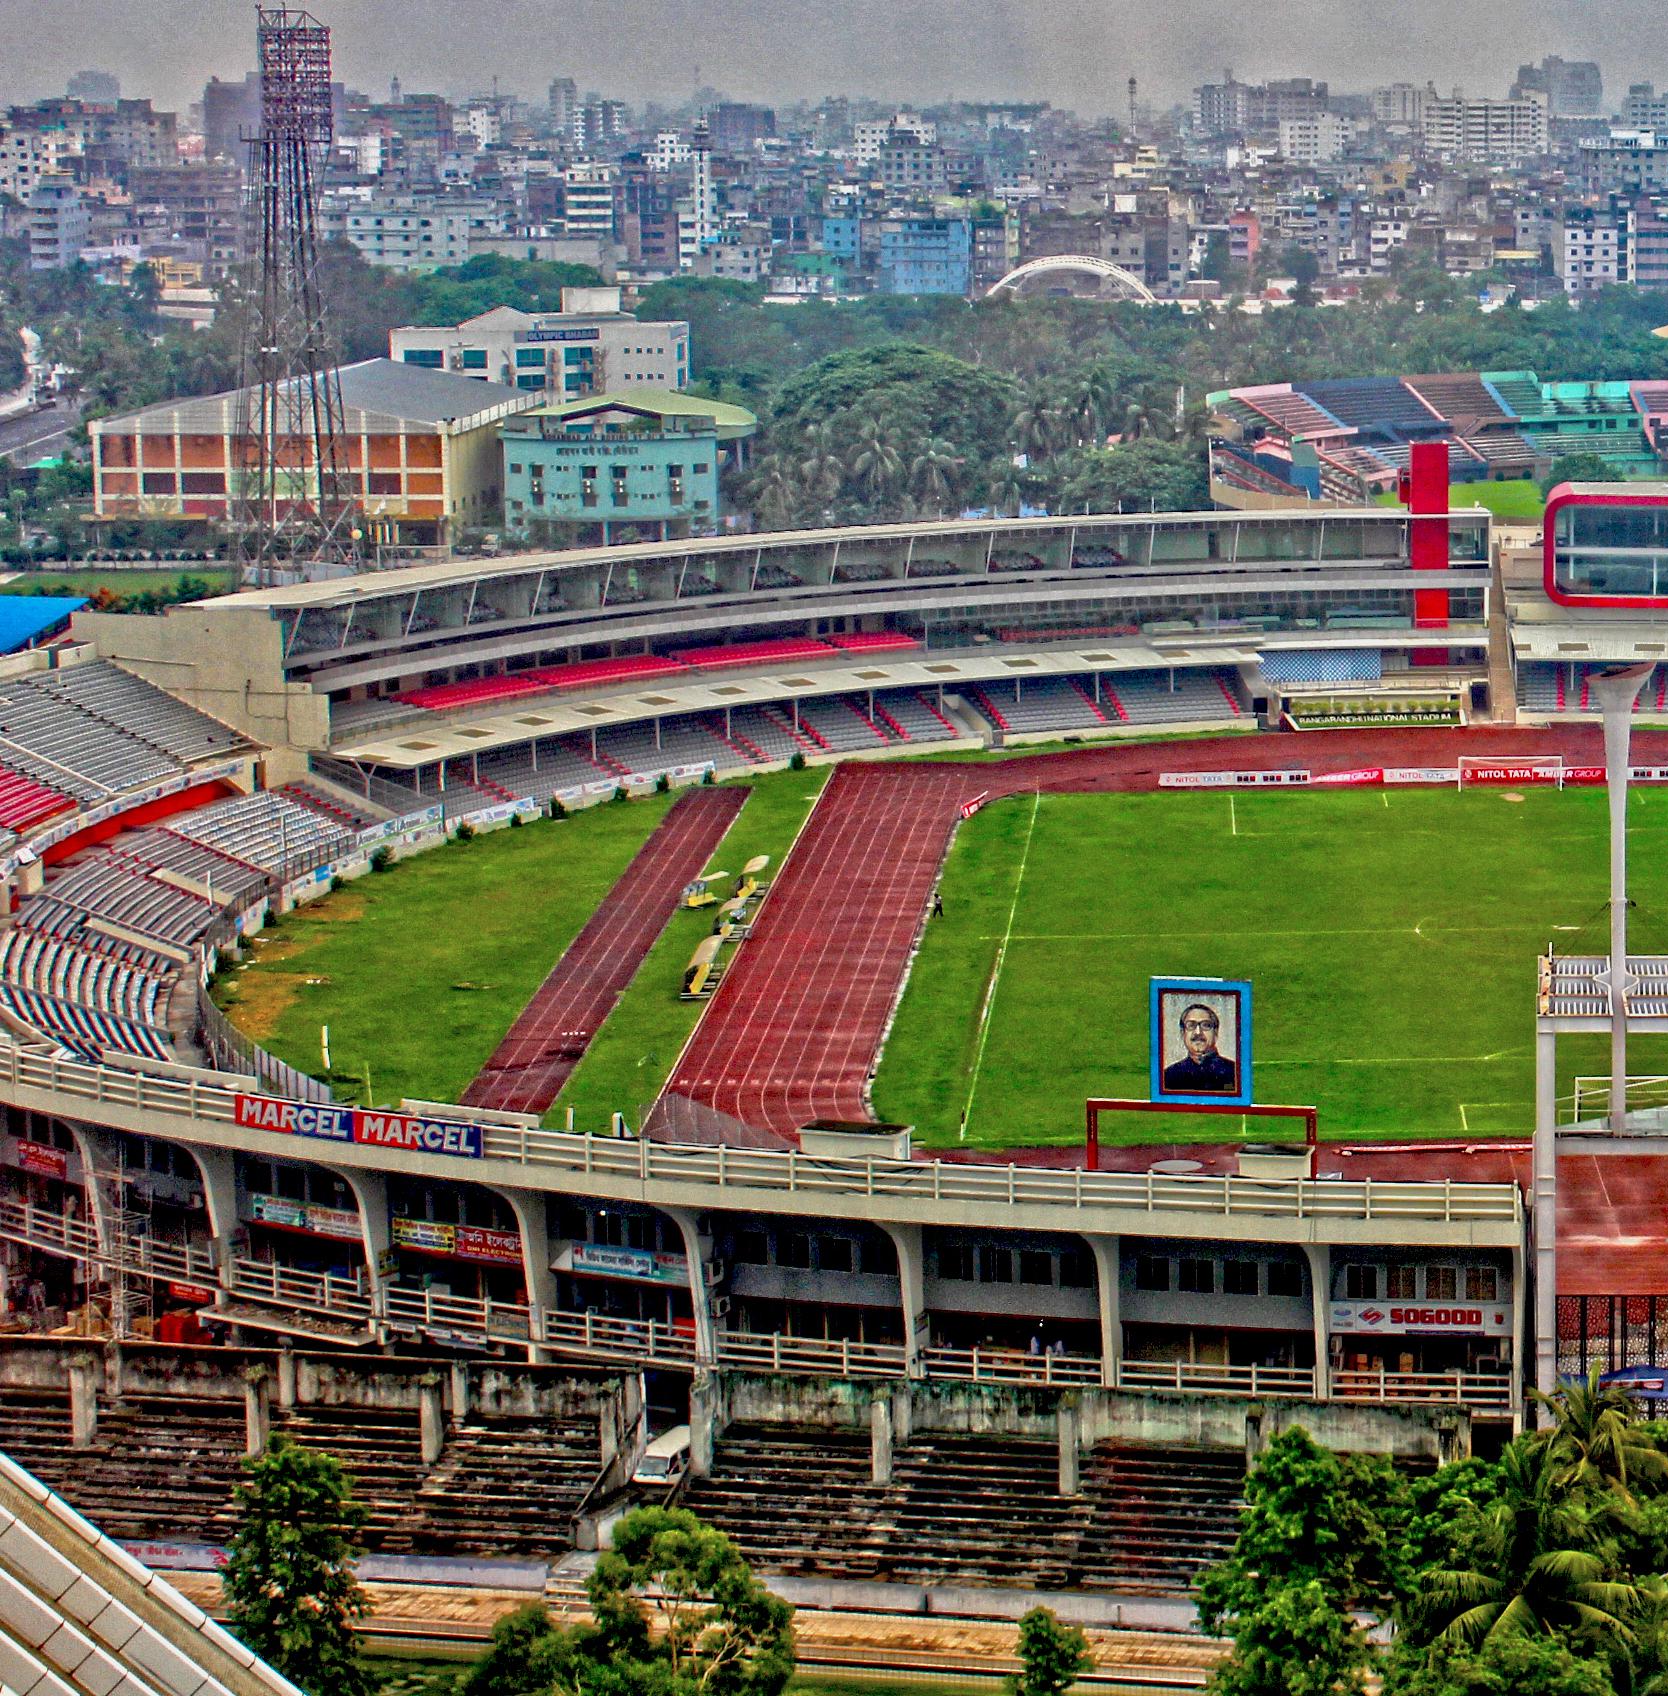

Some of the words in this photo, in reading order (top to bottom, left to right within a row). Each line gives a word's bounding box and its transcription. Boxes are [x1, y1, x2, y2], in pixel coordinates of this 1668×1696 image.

[1351, 770, 1379, 781] GROUP
[1399, 772, 1423, 780] NITOL
[1477, 769, 1507, 779] NITOL
[1508, 769, 1532, 779] TATA
[1574, 769, 1602, 779] GROUP
[241, 1097, 348, 1138] MARCEL
[361, 1116, 476, 1153] MARCEL
[1390, 1308, 1482, 1325] SOGOOD
